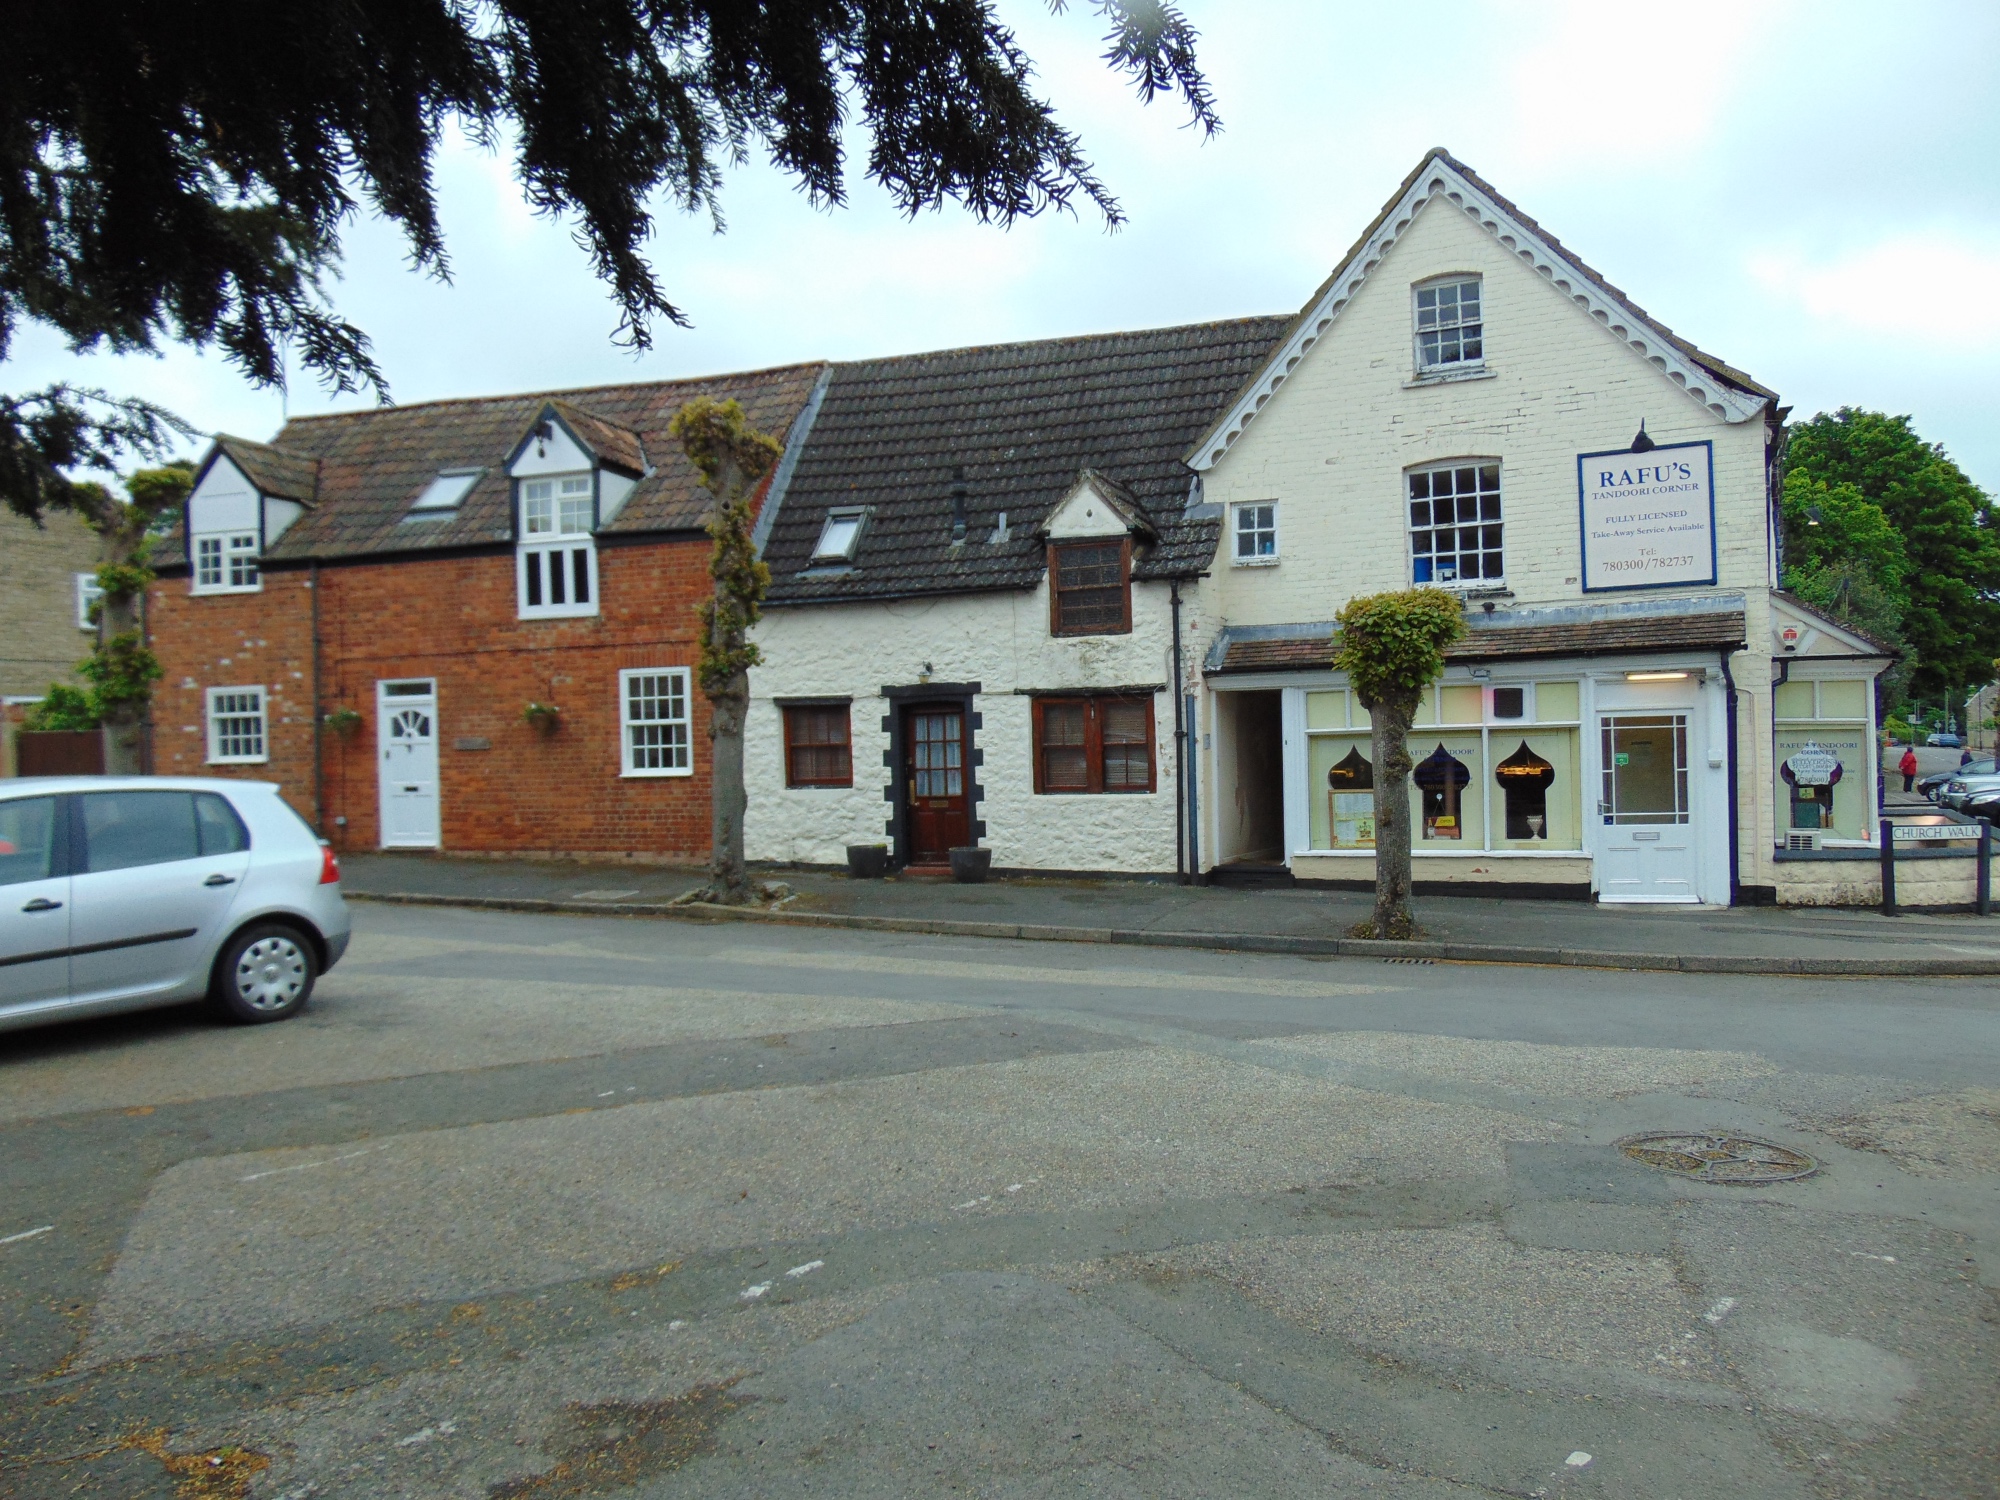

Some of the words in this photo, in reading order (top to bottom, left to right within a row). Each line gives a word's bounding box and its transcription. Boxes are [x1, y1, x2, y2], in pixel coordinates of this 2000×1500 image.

[1599, 462, 1692, 488] RAFU'S
[1592, 487, 1650, 500] TANDOORI
[1652, 483, 1699, 495] CORNER
[1605, 515, 1636, 524] FULLY
[1638, 510, 1688, 521] LICENSED
[1591, 529, 1635, 539] Take-Away
[1637, 527, 1665, 535] Service
[1667, 523, 1705, 533] Available
[1638, 548, 1656, 556] Tel:
[1602, 555, 1694, 572] 780300/782737
[1893, 827, 1942, 839] CHURCH
[1947, 826, 1979, 838] WALK
